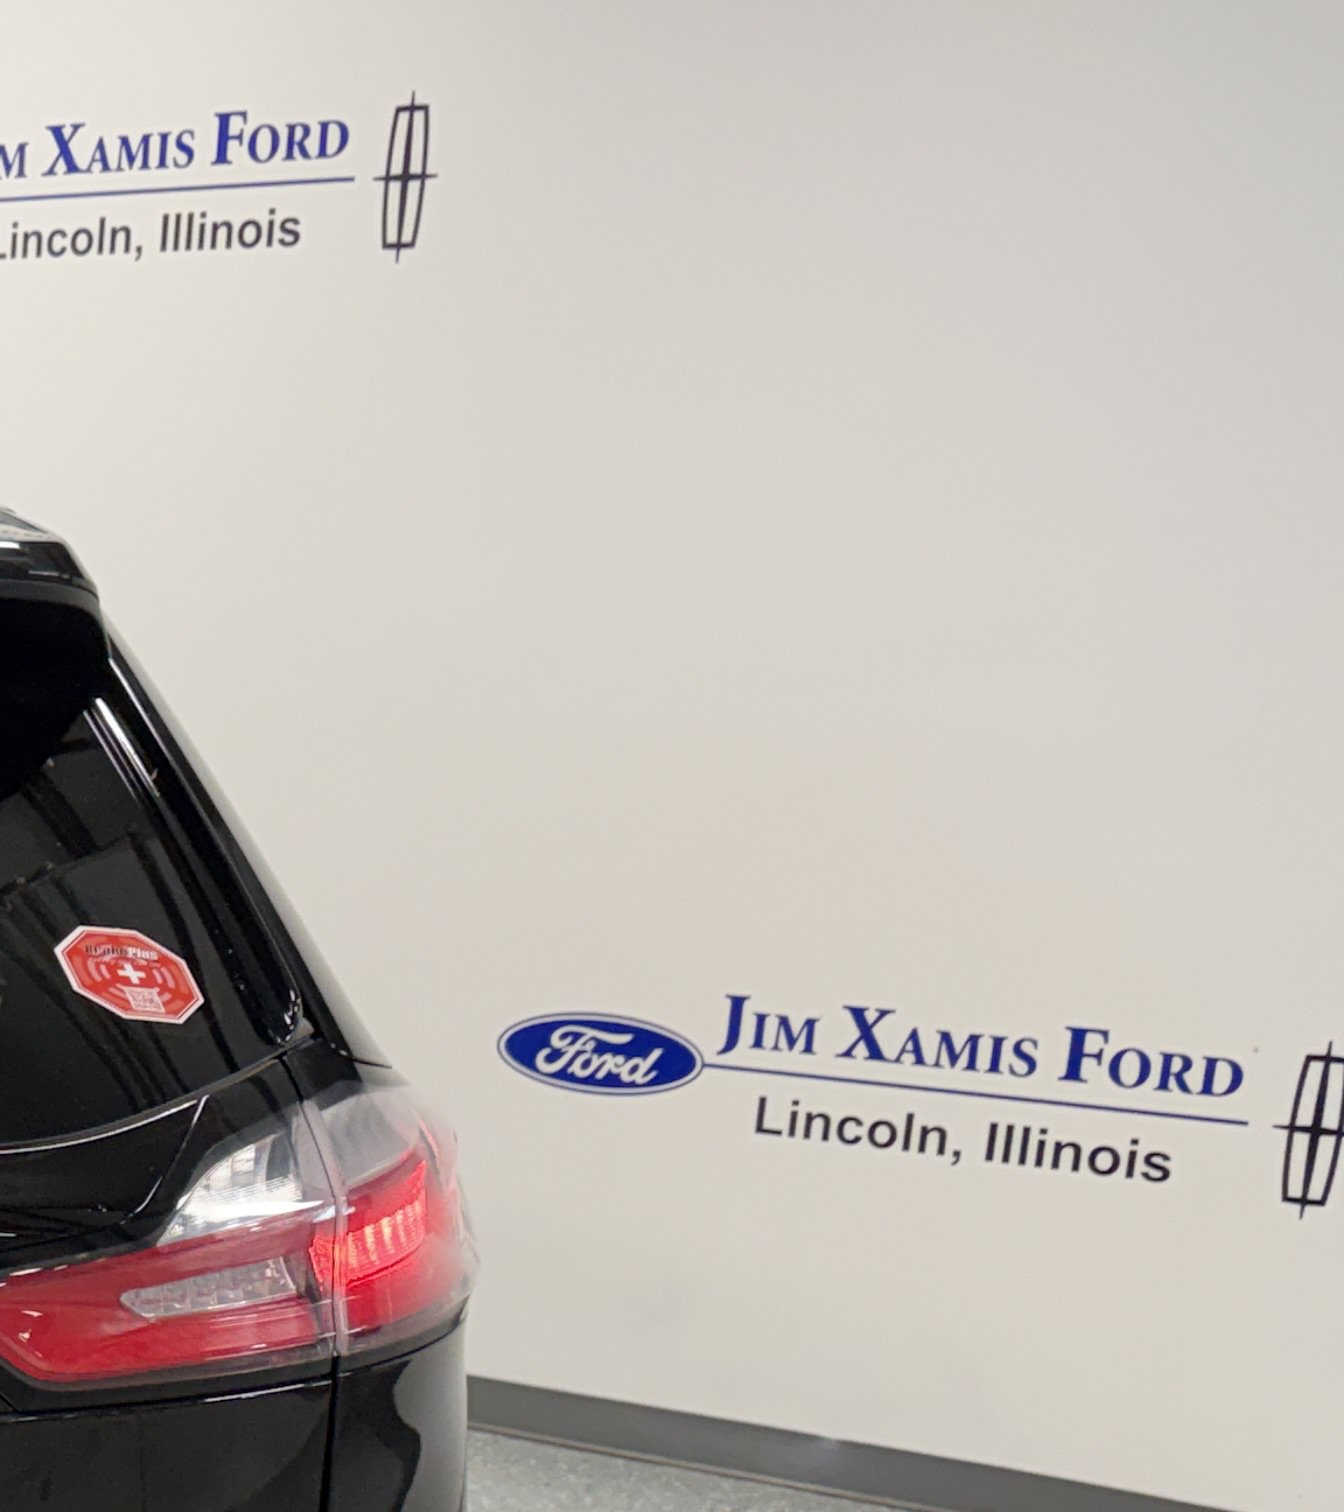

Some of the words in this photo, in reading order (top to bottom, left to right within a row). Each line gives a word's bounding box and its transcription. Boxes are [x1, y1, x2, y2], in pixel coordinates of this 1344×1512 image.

[42, 122, 196, 177] XAMIS
[211, 110, 350, 165] FORD
[158, 208, 302, 253] Illinois
[534, 1023, 660, 1087] Ford
[716, 994, 822, 1056] JIM
[838, 1004, 1038, 1078] XAMIS
[1058, 1026, 1245, 1099] FORD
[754, 1096, 963, 1167] Lincoln,
[983, 1122, 1173, 1184] Illinois
